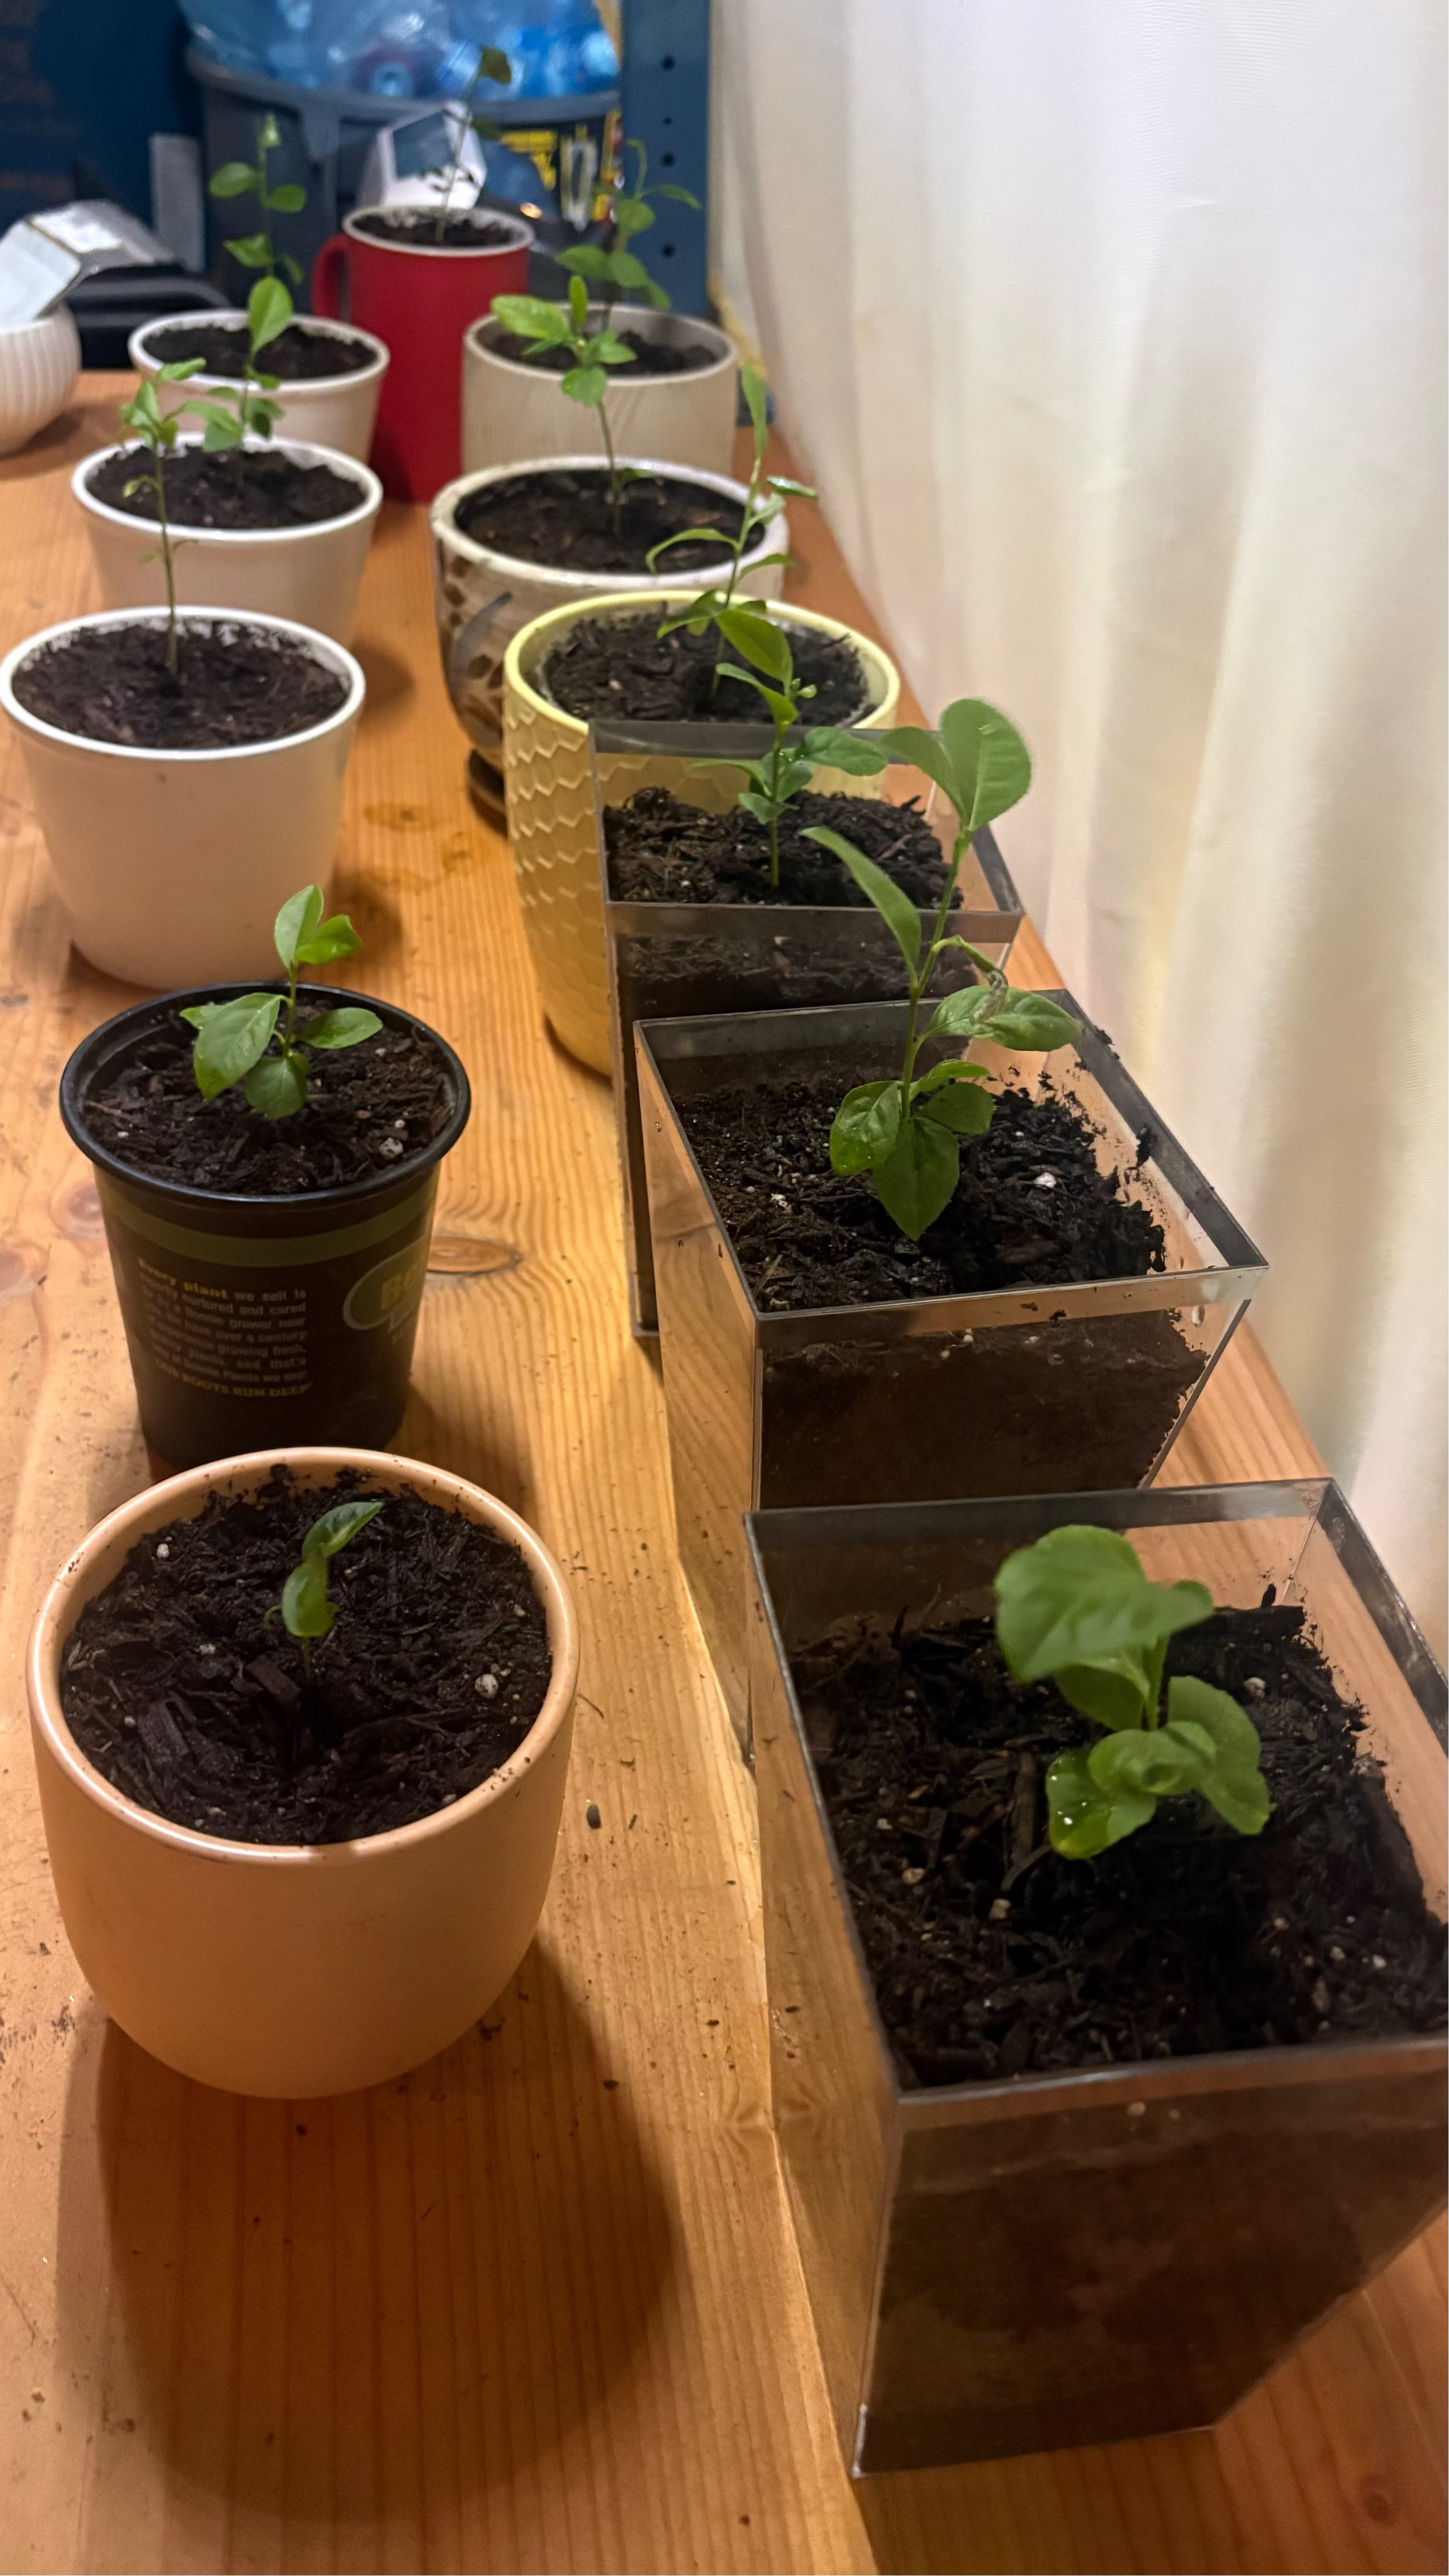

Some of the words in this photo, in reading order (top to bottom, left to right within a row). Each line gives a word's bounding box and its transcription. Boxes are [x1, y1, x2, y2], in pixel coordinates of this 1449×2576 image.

[184, 1281, 228, 1299] plant
[234, 1292, 254, 1301] we
[263, 1291, 286, 1301] sell
[295, 1289, 306, 1298] is
[240, 1306, 263, 1315] and
[270, 1302, 306, 1315] cared
[230, 1319, 272, 1330] grower
[279, 1317, 307, 1327] near
[216, 1331, 241, 1341] over
[259, 1331, 307, 1342] century
[218, 1344, 268, 1357] growing
[237, 1360, 260, 1369] and
[183, 1373, 229, 1394] ROOTS
[232, 1387, 265, 1396] RUN
